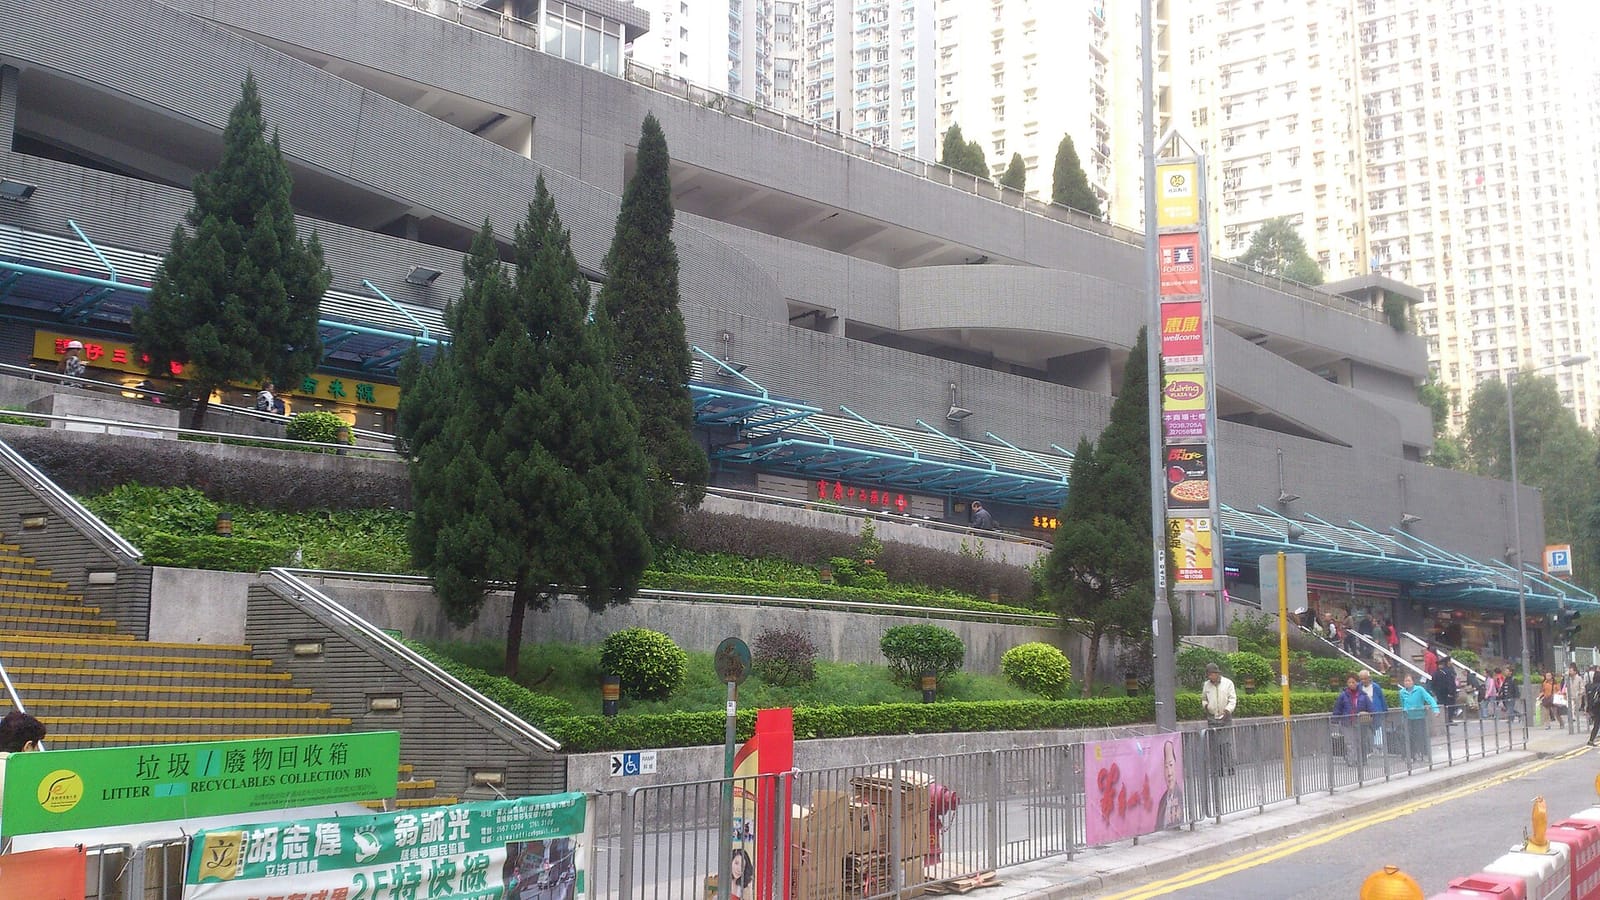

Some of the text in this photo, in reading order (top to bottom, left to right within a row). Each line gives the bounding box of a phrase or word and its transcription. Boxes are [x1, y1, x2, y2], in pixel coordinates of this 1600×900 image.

[1163, 316, 1200, 333] 惠康
[1555, 553, 1565, 565] P
[102, 785, 150, 801] LITTER
[190, 774, 276, 793] RECYCLABLES
[280, 769, 350, 785] COLLECTION
[354, 767, 372, 778] BIN
[247, 822, 342, 864] 胡志偉
[393, 808, 471, 847] 翁誠光
[352, 853, 490, 900] 2F特快線
